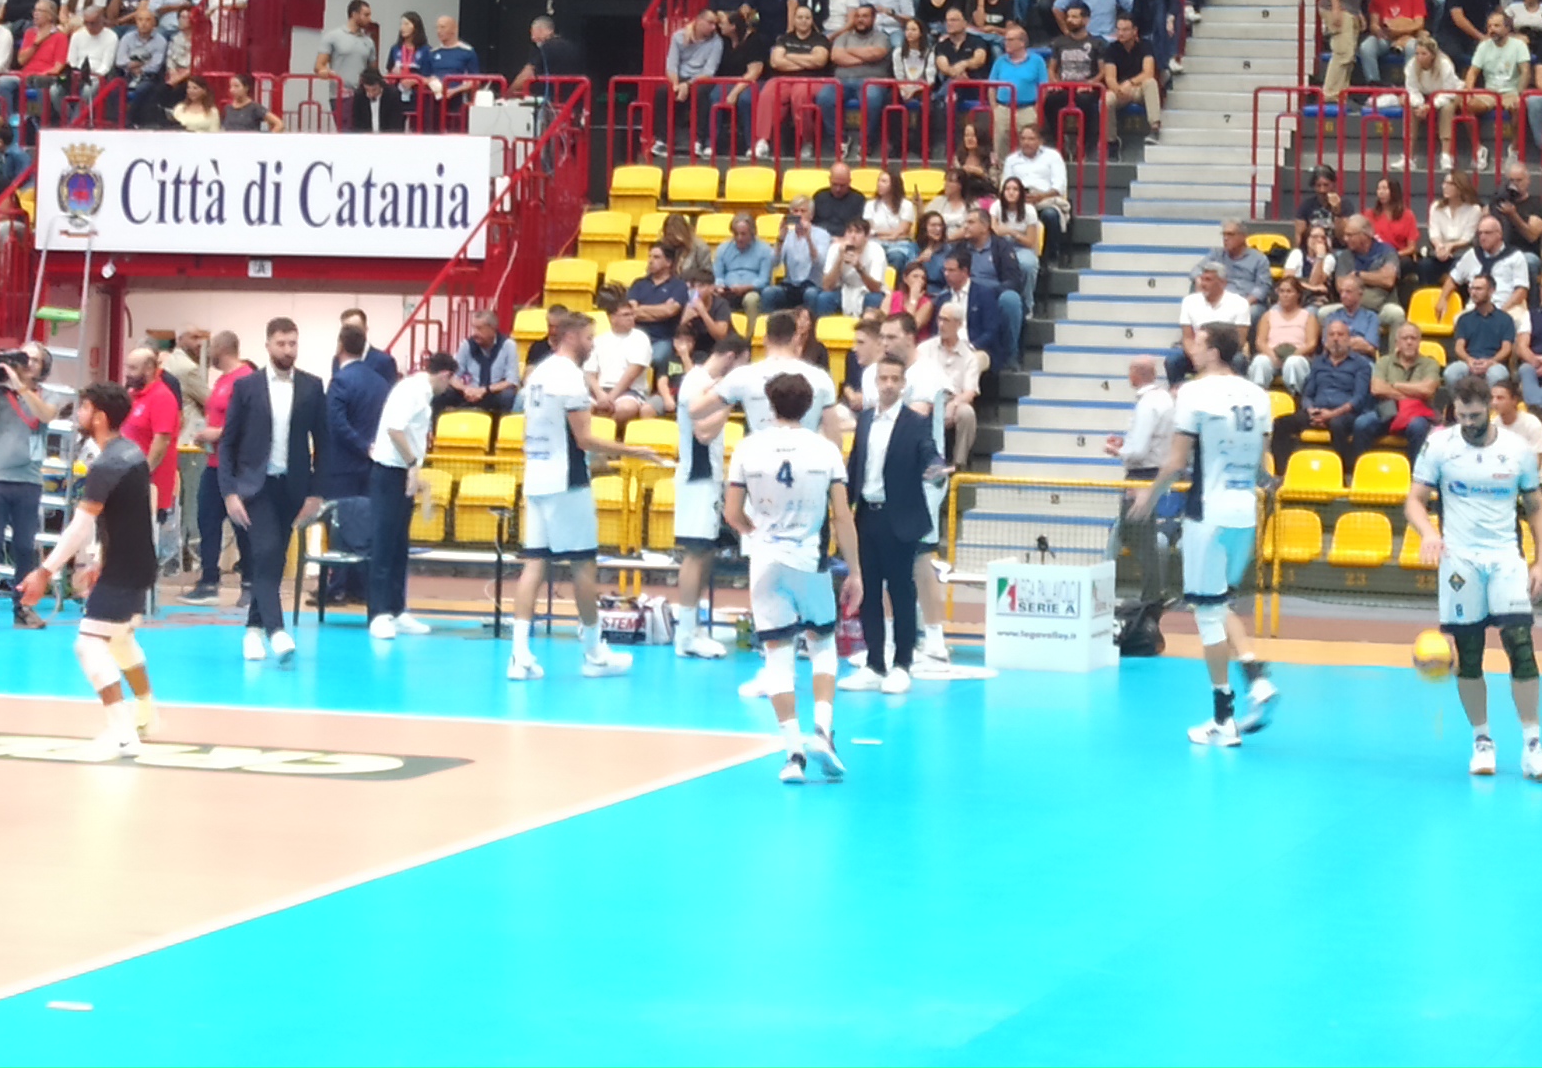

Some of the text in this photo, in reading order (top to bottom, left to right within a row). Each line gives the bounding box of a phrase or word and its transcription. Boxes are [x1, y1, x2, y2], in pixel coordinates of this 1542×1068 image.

[120, 158, 471, 229] Città di Catania
[1230, 405, 1255, 432] 18
[776, 459, 795, 488] 4
[1018, 603, 1076, 615] SERIE A
